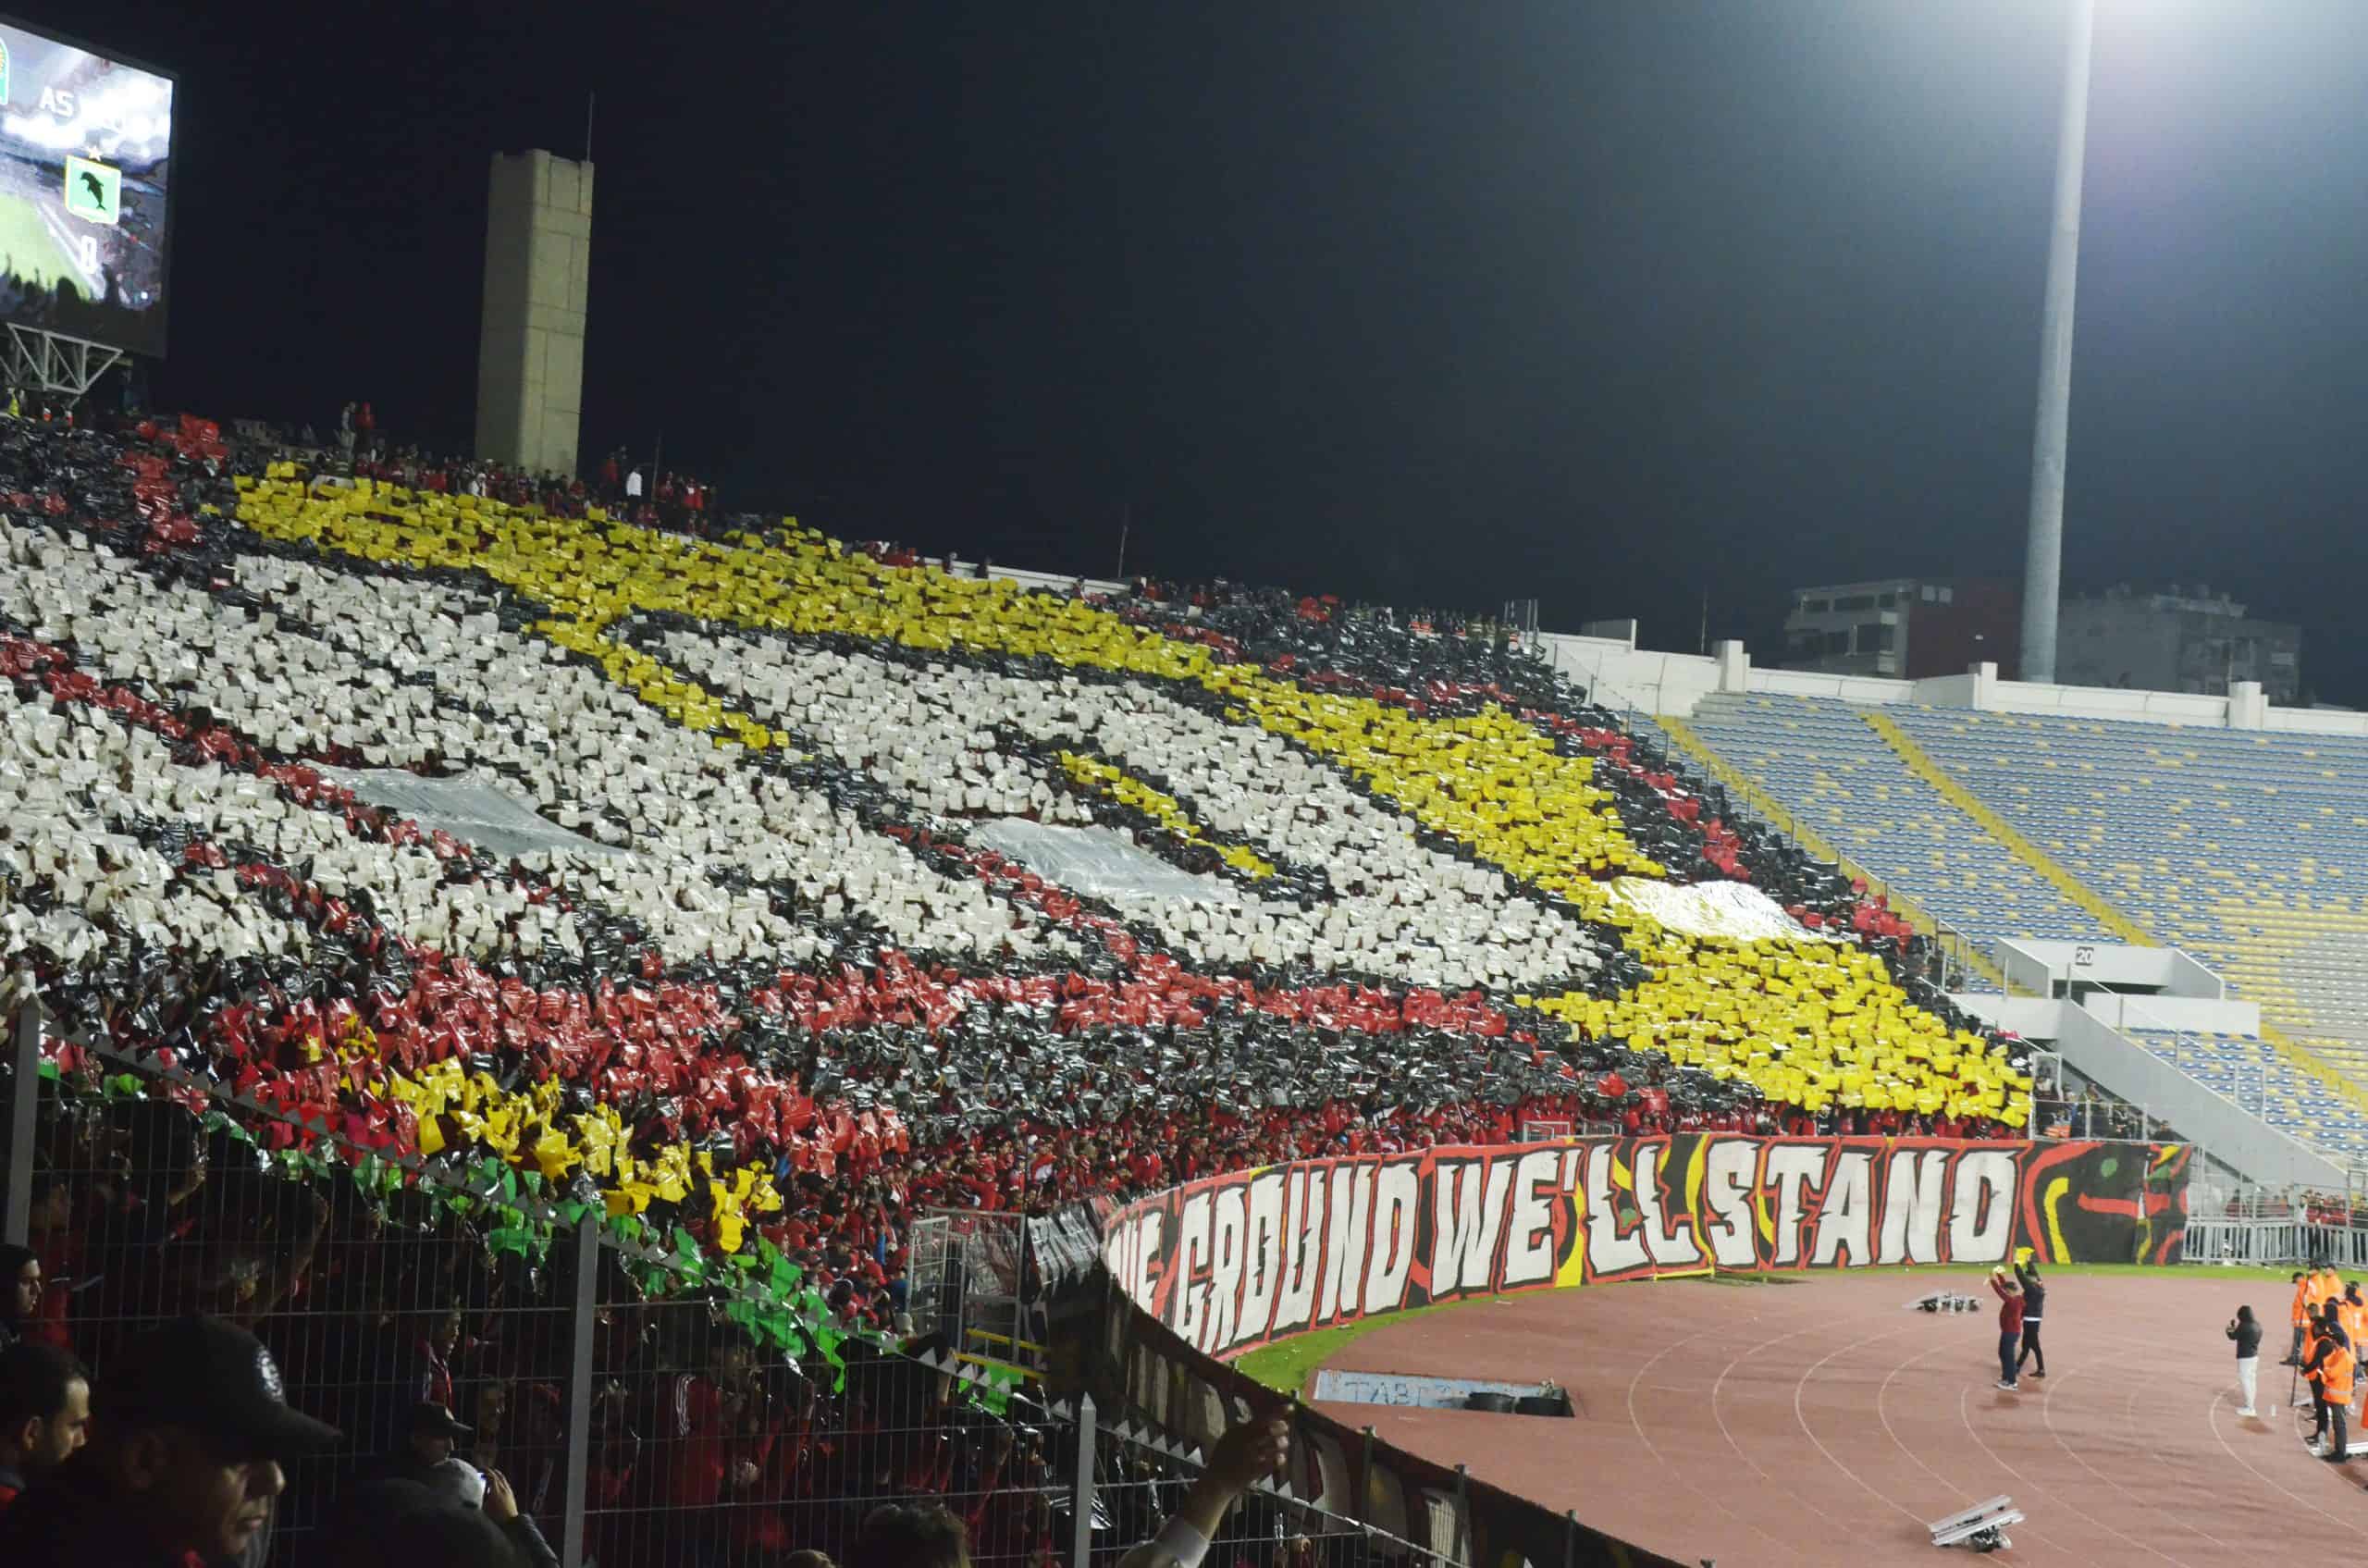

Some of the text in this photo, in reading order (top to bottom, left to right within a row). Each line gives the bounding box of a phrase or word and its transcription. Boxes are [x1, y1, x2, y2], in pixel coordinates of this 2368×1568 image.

[2078, 948, 2094, 964] 20
[1173, 1162, 1419, 1354] GROUND
[1708, 1140, 2018, 1267] STAND
